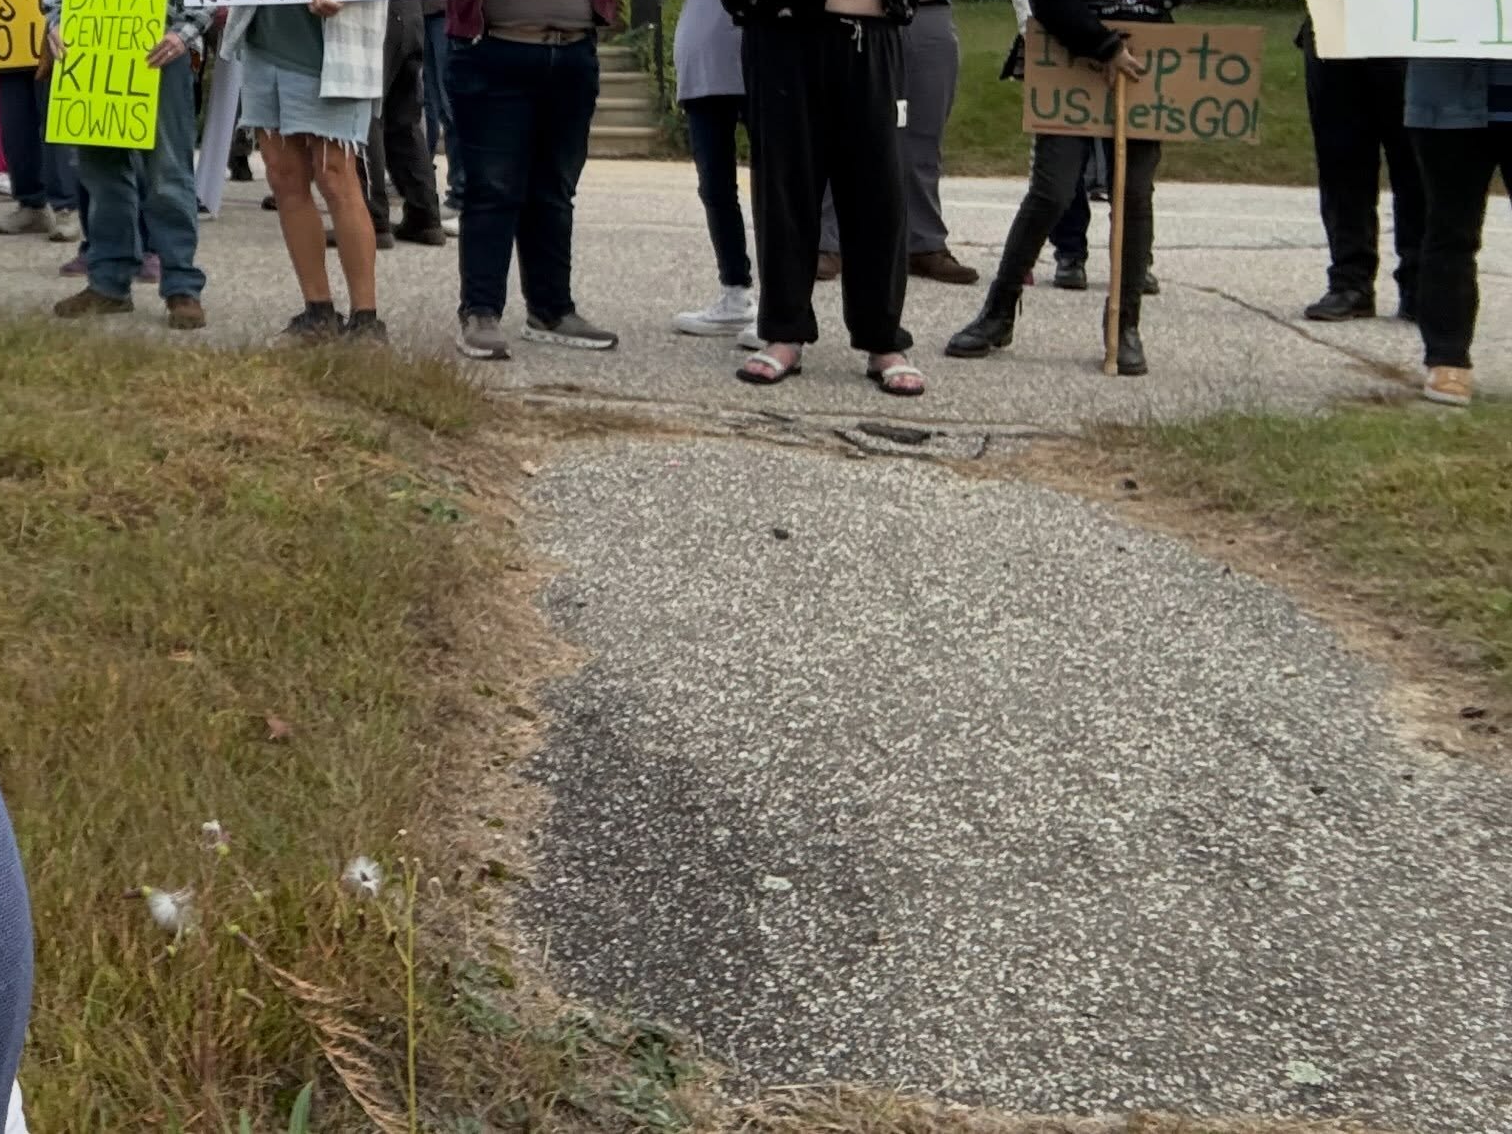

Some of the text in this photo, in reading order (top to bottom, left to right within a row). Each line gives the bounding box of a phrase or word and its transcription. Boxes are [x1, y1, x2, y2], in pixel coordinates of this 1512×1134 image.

[63, 14, 161, 53] CENTERS
[58, 52, 150, 97] KILL
[1186, 32, 1250, 85] to
[53, 97, 149, 142] TOWNS
[1190, 96, 1259, 139] GO!
